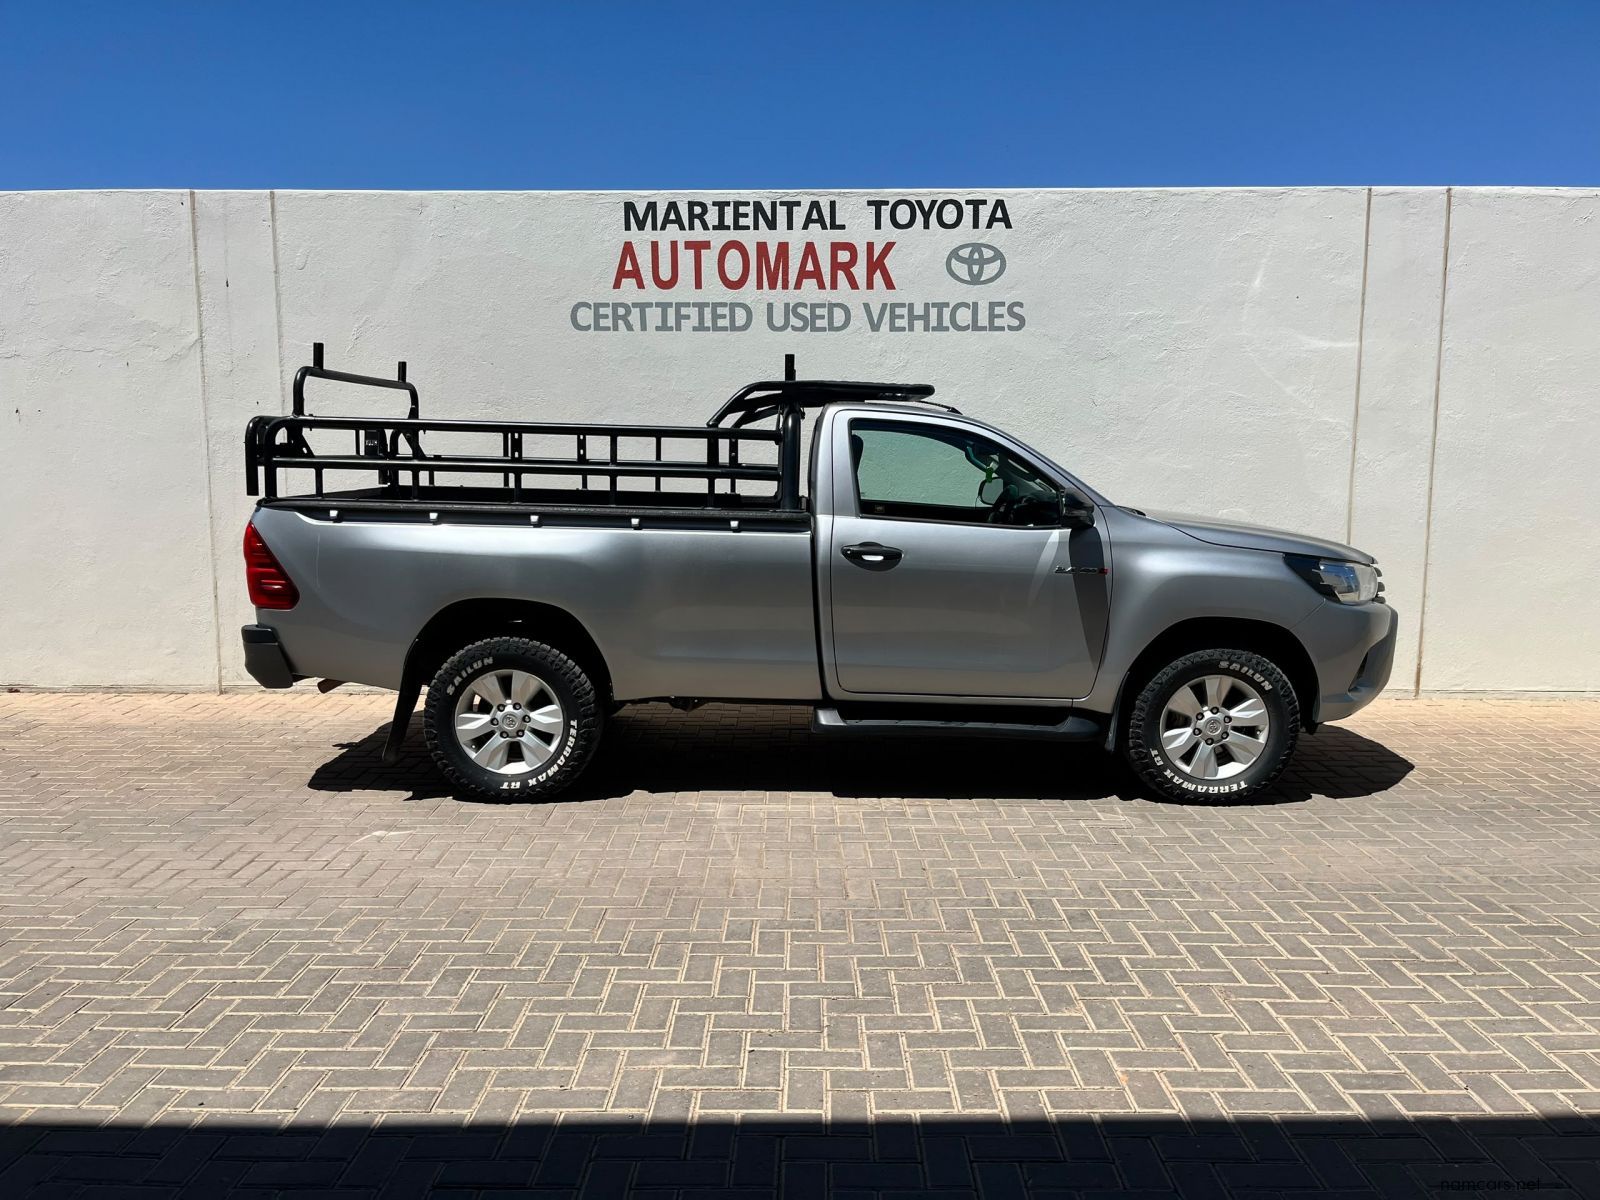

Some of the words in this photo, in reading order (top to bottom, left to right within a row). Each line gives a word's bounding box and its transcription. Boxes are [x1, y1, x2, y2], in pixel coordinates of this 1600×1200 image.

[623, 200, 846, 232] MARIENTAL
[868, 199, 1013, 230] TOYOTA
[612, 240, 897, 290] AUTOMARK
[570, 302, 753, 332] CERTIFIED
[766, 301, 852, 332] USED
[863, 301, 1026, 332] VEHICLES
[446, 656, 494, 696] SAILUN
[1218, 660, 1273, 691] SAILUN
[528, 718, 578, 787] TERRAMAX
[1164, 768, 1248, 794] TERRAMAX
